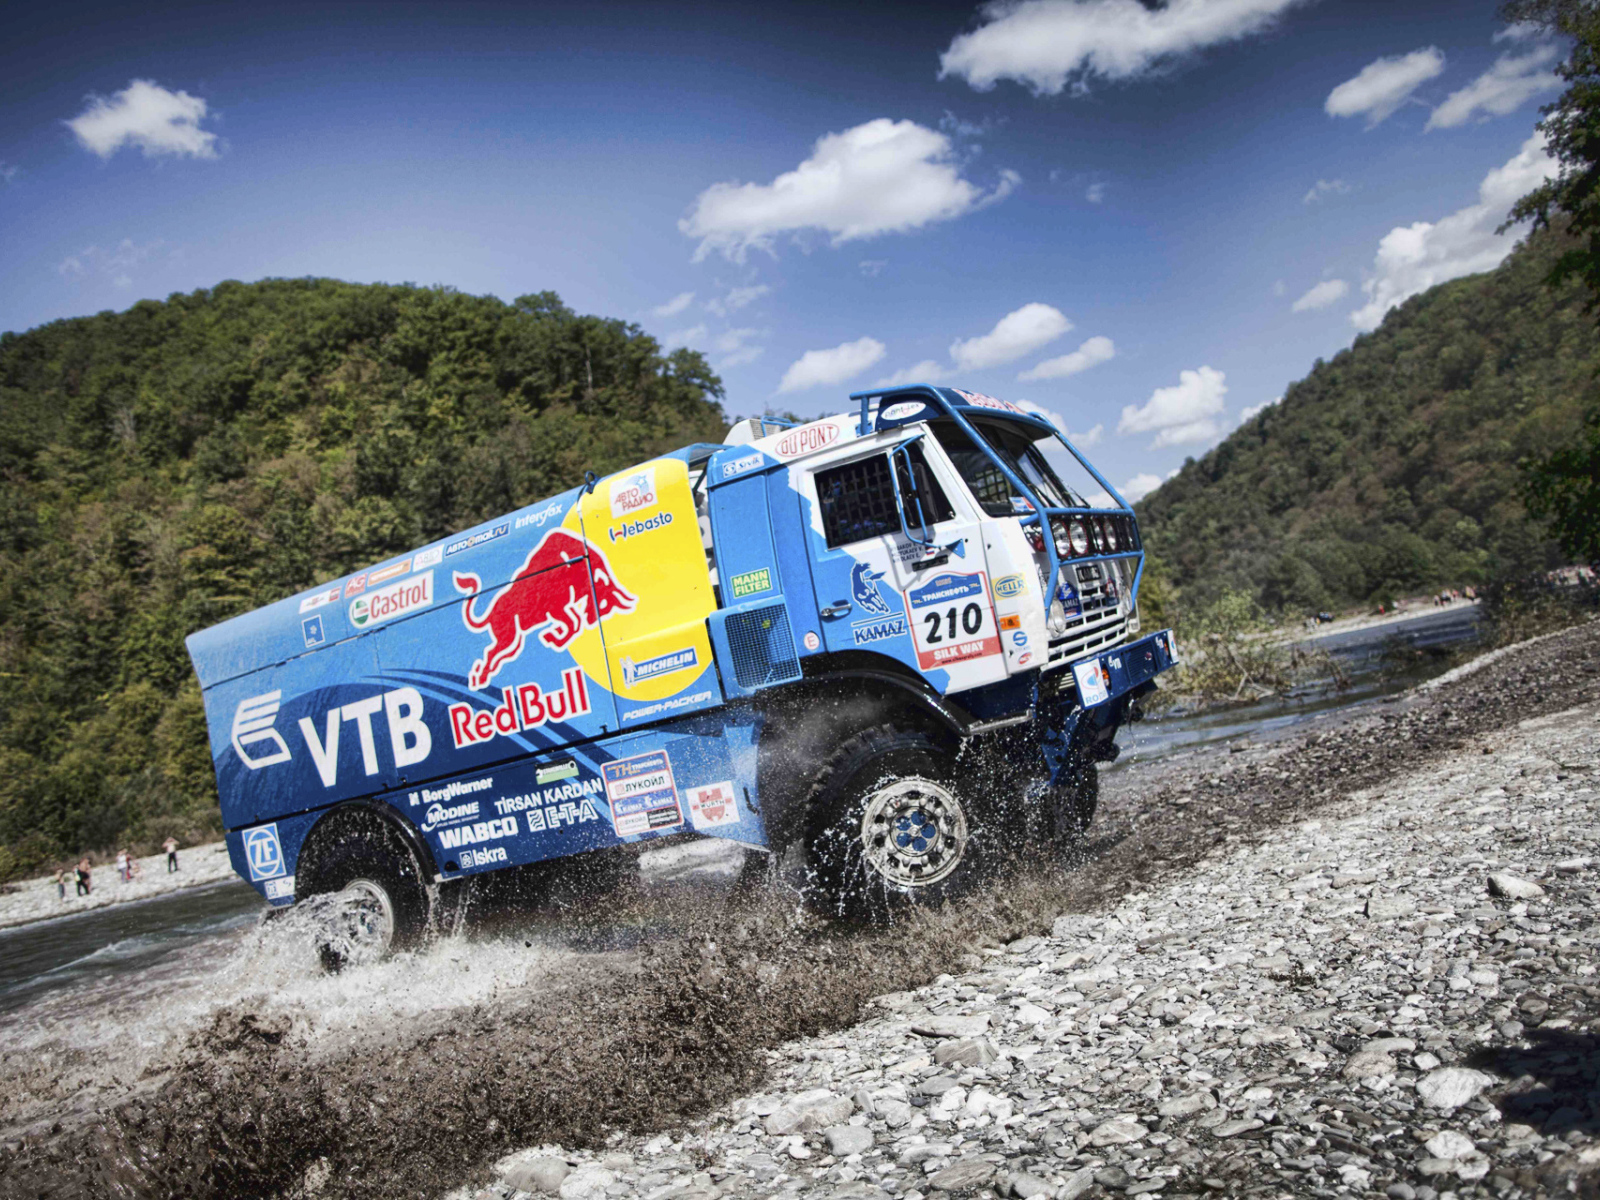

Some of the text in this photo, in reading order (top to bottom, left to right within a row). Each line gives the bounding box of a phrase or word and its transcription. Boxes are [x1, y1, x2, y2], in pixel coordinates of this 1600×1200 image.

[609, 512, 673, 542] Webasto
[733, 571, 768, 587] MANN
[735, 580, 770, 597] FILTER
[370, 577, 429, 620] Castrol
[854, 619, 907, 645] KAMAZ
[923, 602, 982, 644] 210
[637, 650, 694, 676] MICHELIN
[933, 641, 985, 660] SILK WAY
[448, 665, 592, 749] Red Bull
[622, 690, 713, 722] POWER-PACKER
[298, 687, 432, 788] VTB
[421, 777, 494, 804] BorgWarner
[543, 777, 604, 804] KARDAN
[625, 776, 665, 793] ЛУКОЙЛ
[427, 801, 480, 824] MODINE
[438, 816, 519, 850] WABCO
[249, 836, 277, 868] ZF
[472, 846, 508, 866] Iskra
